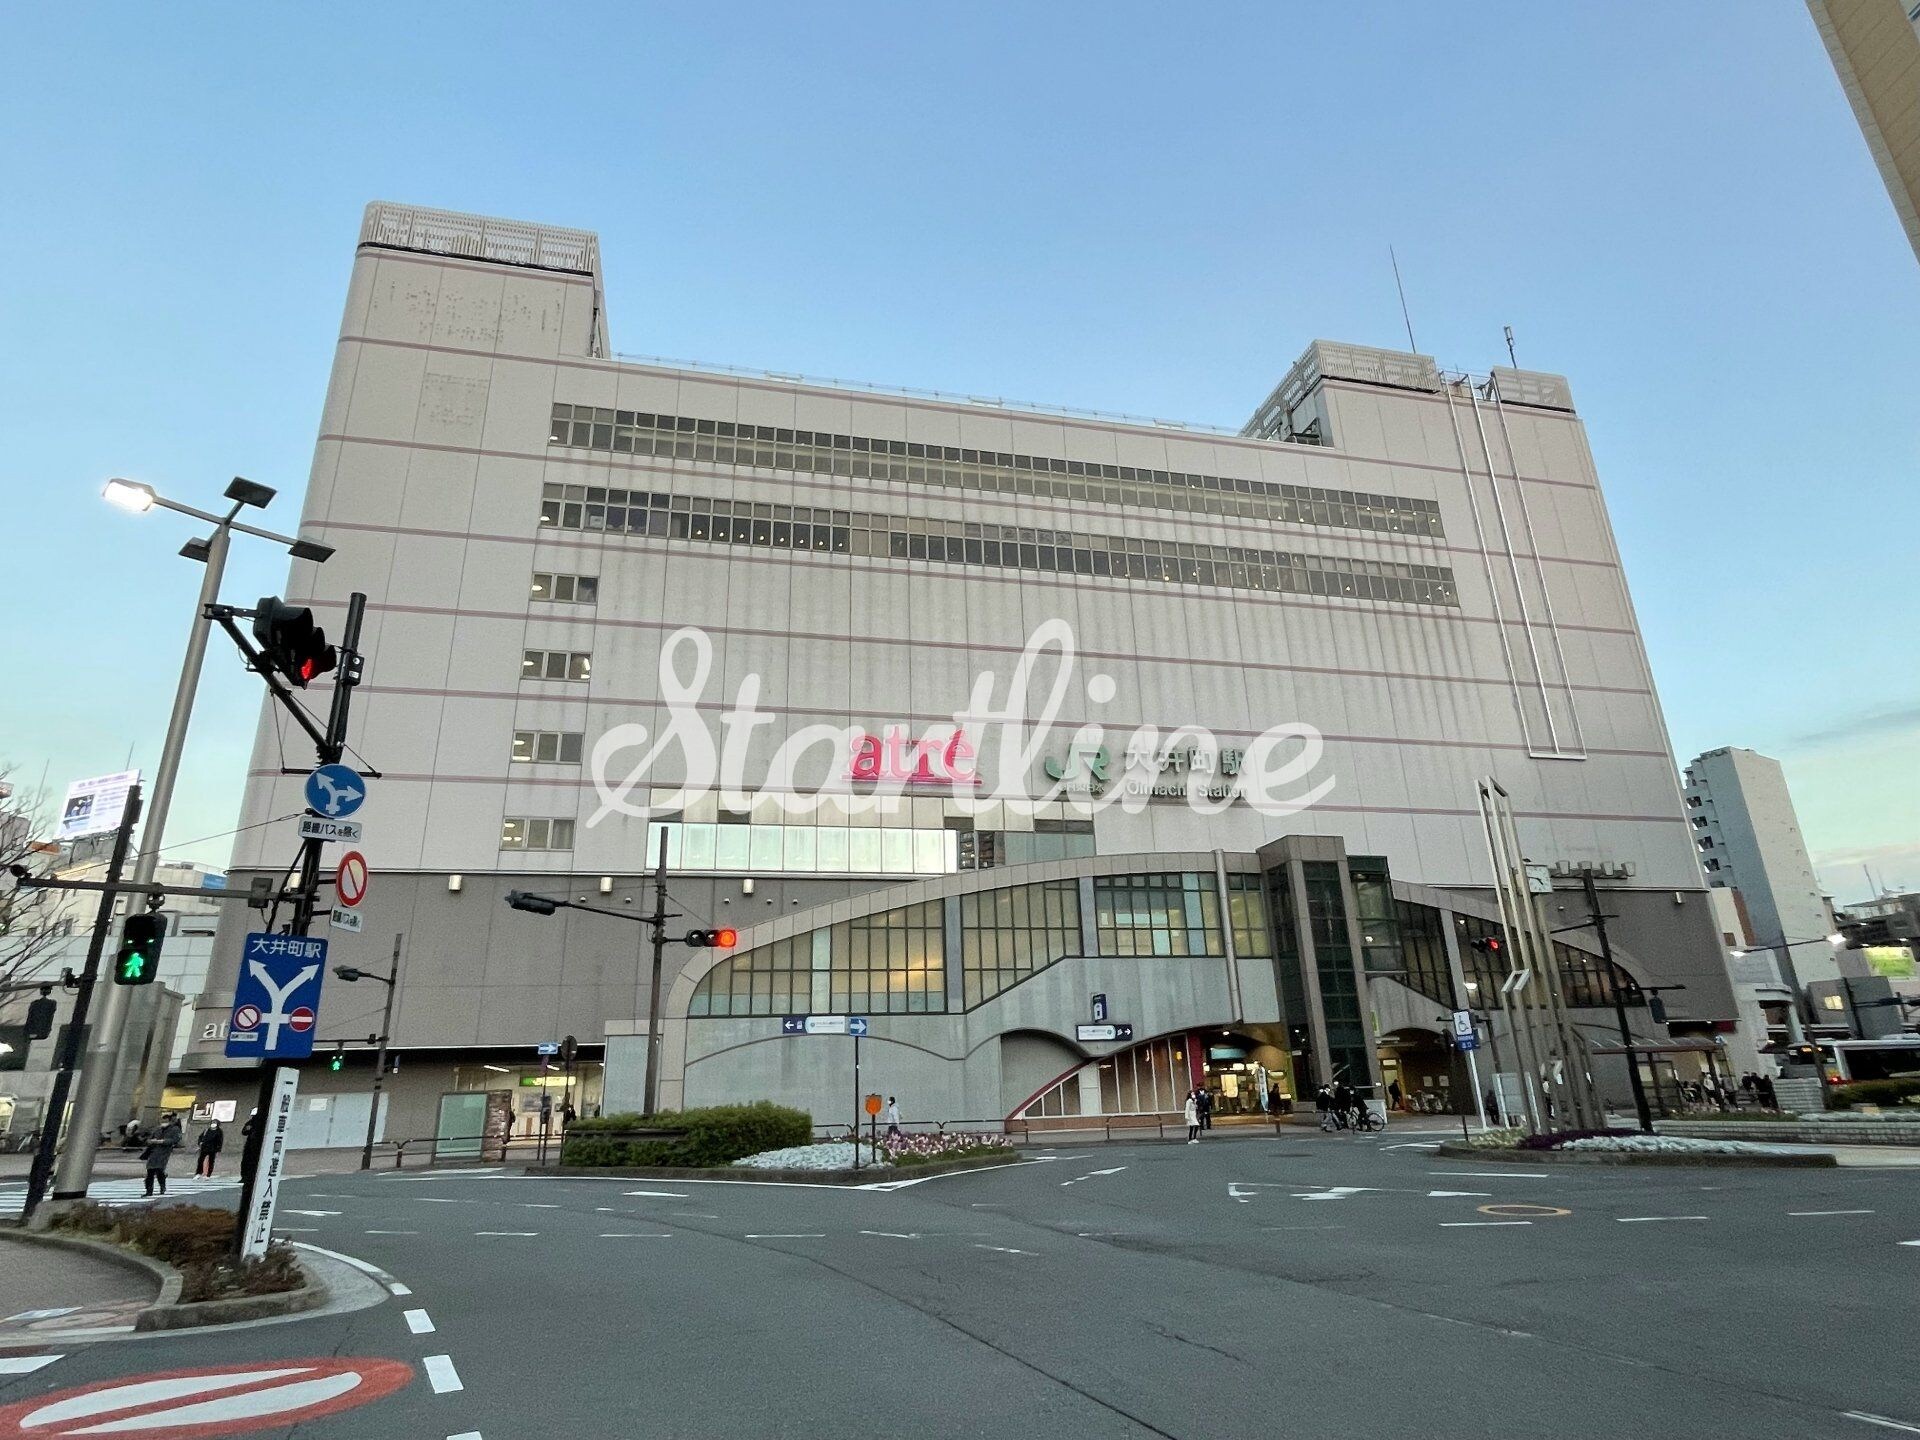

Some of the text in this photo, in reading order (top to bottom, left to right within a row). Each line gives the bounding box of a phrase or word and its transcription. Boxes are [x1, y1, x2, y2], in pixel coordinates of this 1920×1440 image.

[850, 724, 976, 781] atré
[1124, 746, 1248, 776] 大井町駅
[251, 938, 321, 958] 大井町駅
